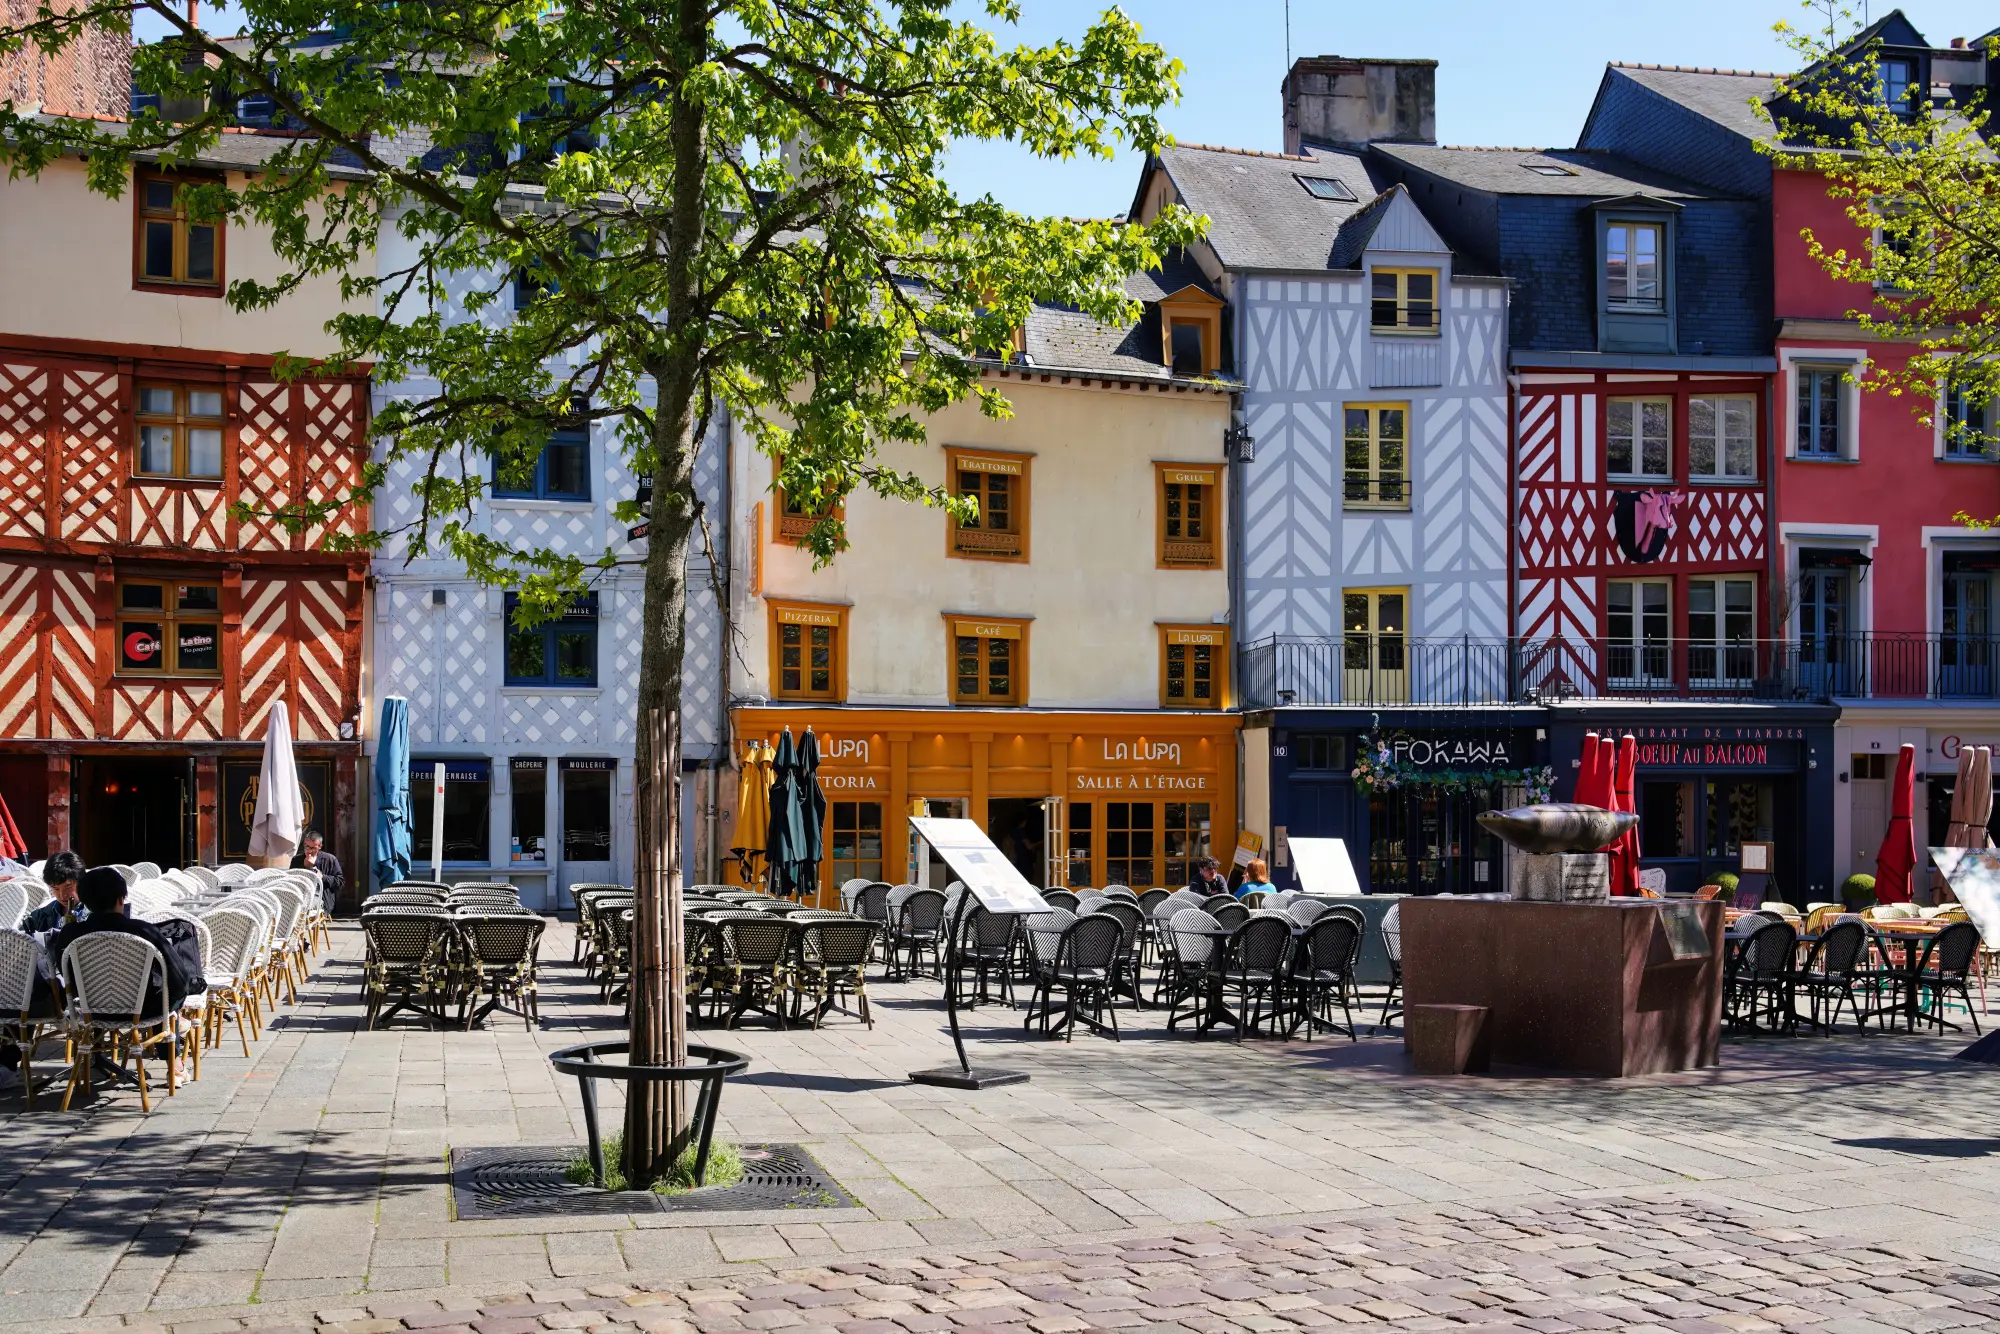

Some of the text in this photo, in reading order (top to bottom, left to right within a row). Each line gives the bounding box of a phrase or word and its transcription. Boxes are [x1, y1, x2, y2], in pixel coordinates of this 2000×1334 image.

[962, 460, 1017, 473] TRATTORIA
[1176, 473, 1204, 482] GRILL
[785, 612, 831, 623] PIZZERIA
[135, 640, 161, 653] Café
[180, 635, 213, 647] Latino
[1705, 728, 1721, 738] DE
[1736, 728, 1803, 739] VIANDES
[1276, 746, 1285, 756] 10
[1394, 740, 1510, 765] POKAWA
[1683, 748, 1700, 764] AU
[1705, 744, 1768, 765] BALCON
[569, 761, 606, 769] MOULERIE
[410, 771, 478, 780] ÊPERI ENNAISE
[1077, 775, 1123, 789] SALLE
[1128, 774, 1139, 789] À
[816, 776, 877, 788] TORIA
